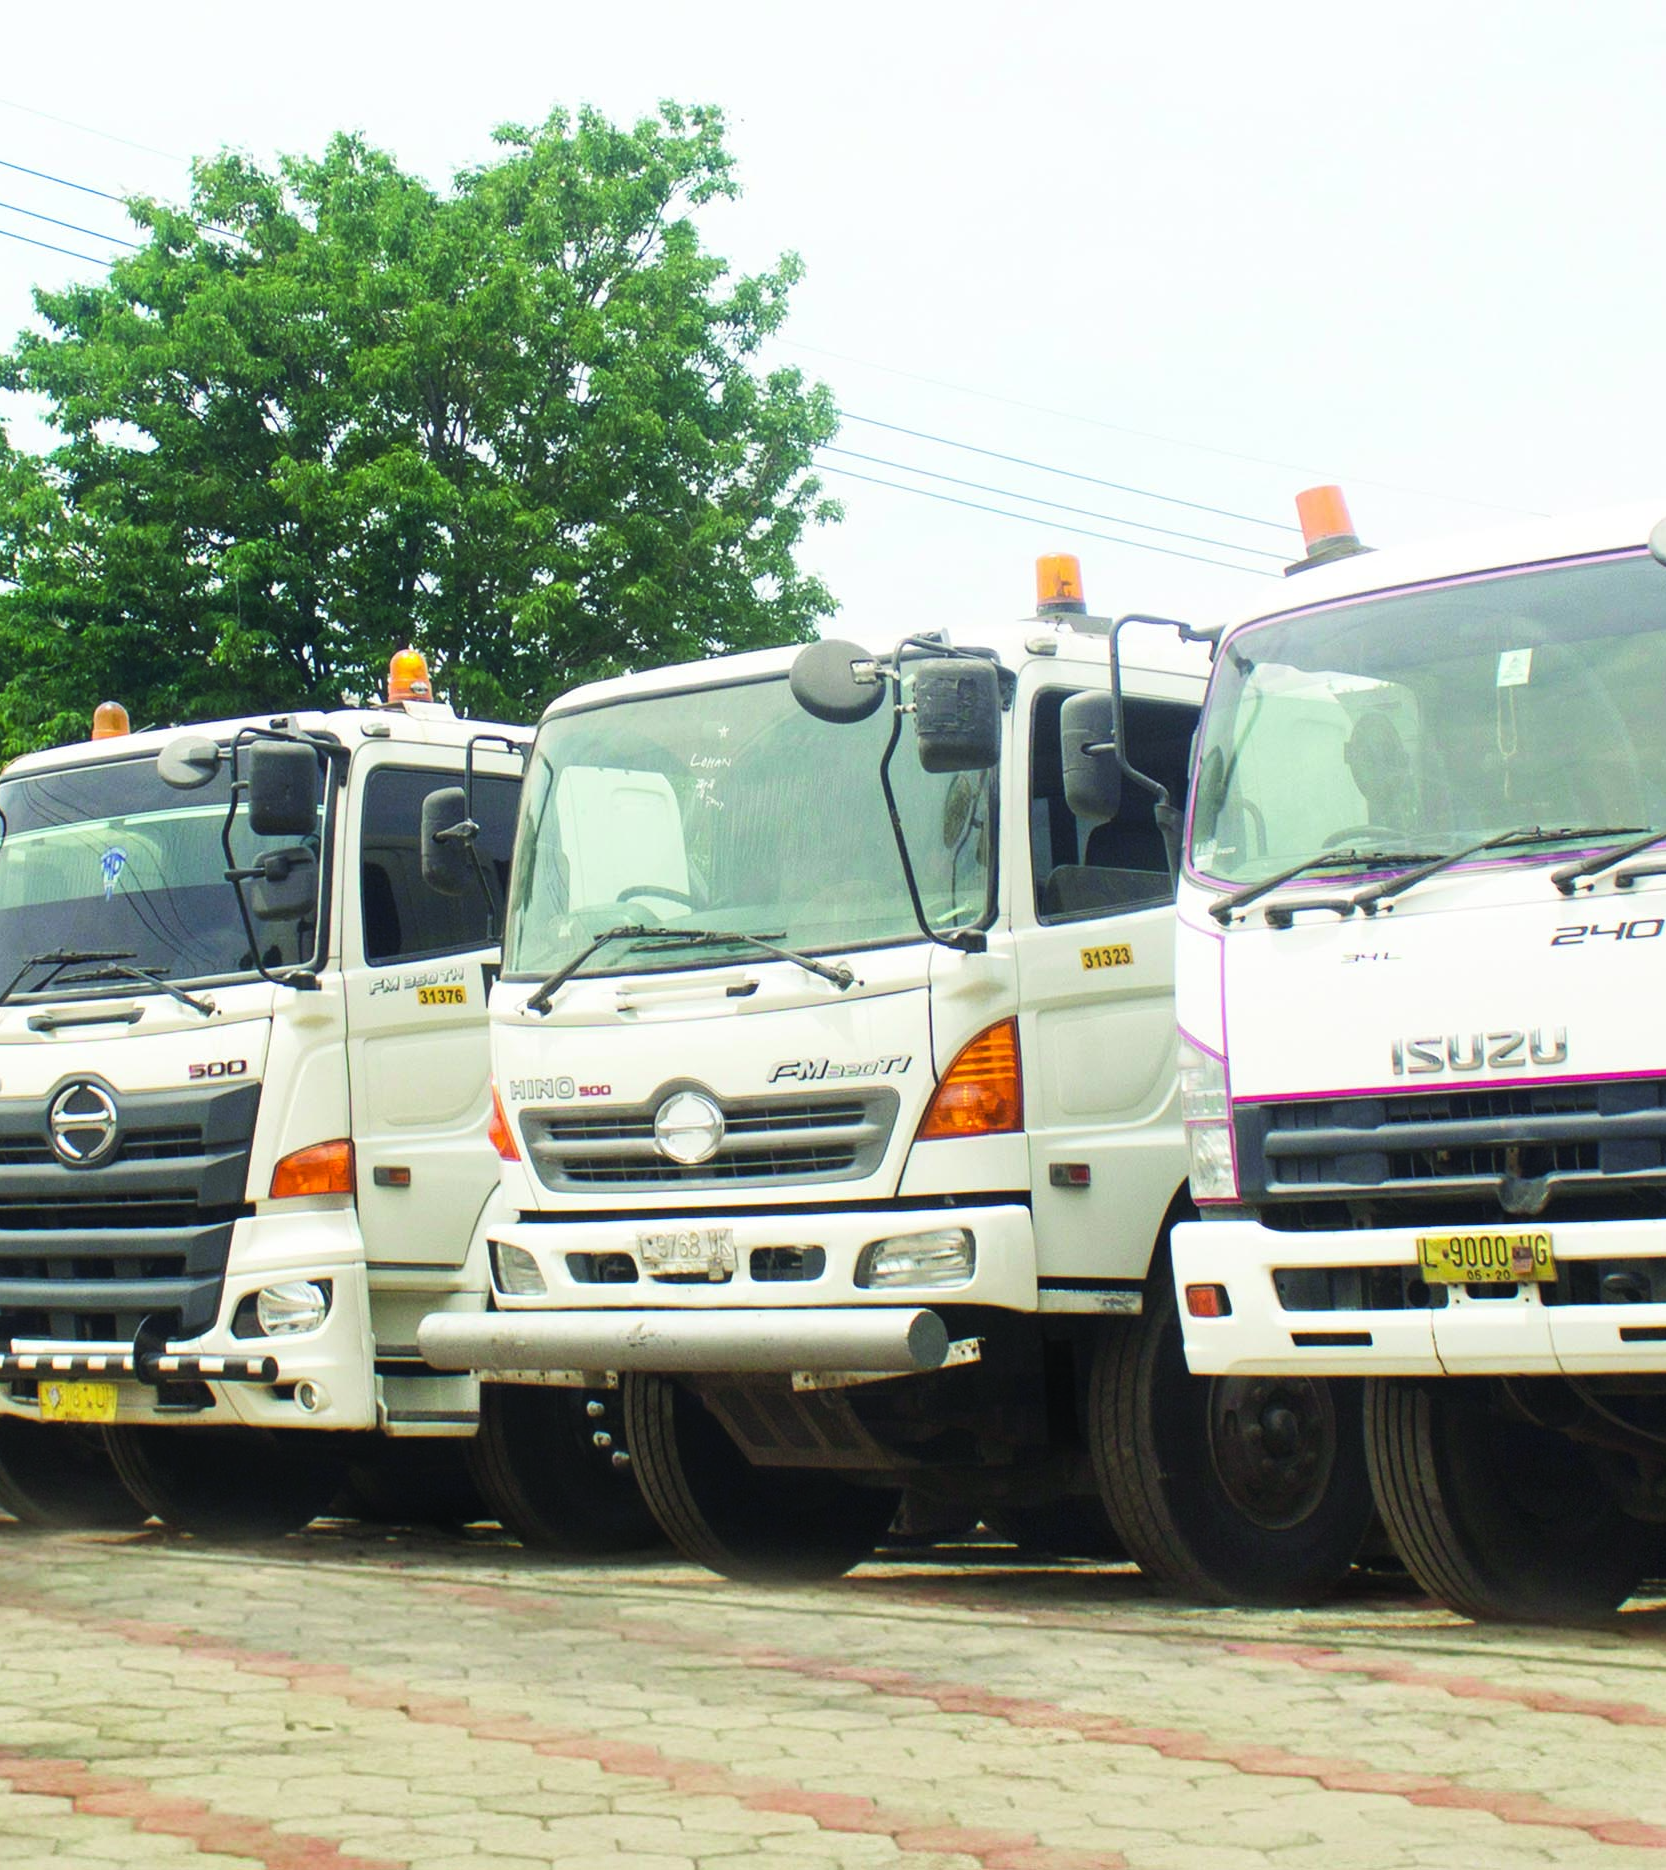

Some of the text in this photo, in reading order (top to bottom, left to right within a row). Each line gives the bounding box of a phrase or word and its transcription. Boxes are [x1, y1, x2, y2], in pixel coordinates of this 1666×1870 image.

[1084, 947, 1130, 969] 31323
[419, 989, 464, 1004] 31376
[1391, 1026, 1568, 1076] ISUZU
[189, 1060, 247, 1079] 500
[510, 1077, 611, 1101] HINO 500
[1423, 1238, 1437, 1268] L
[1450, 1236, 1508, 1267] 9000
